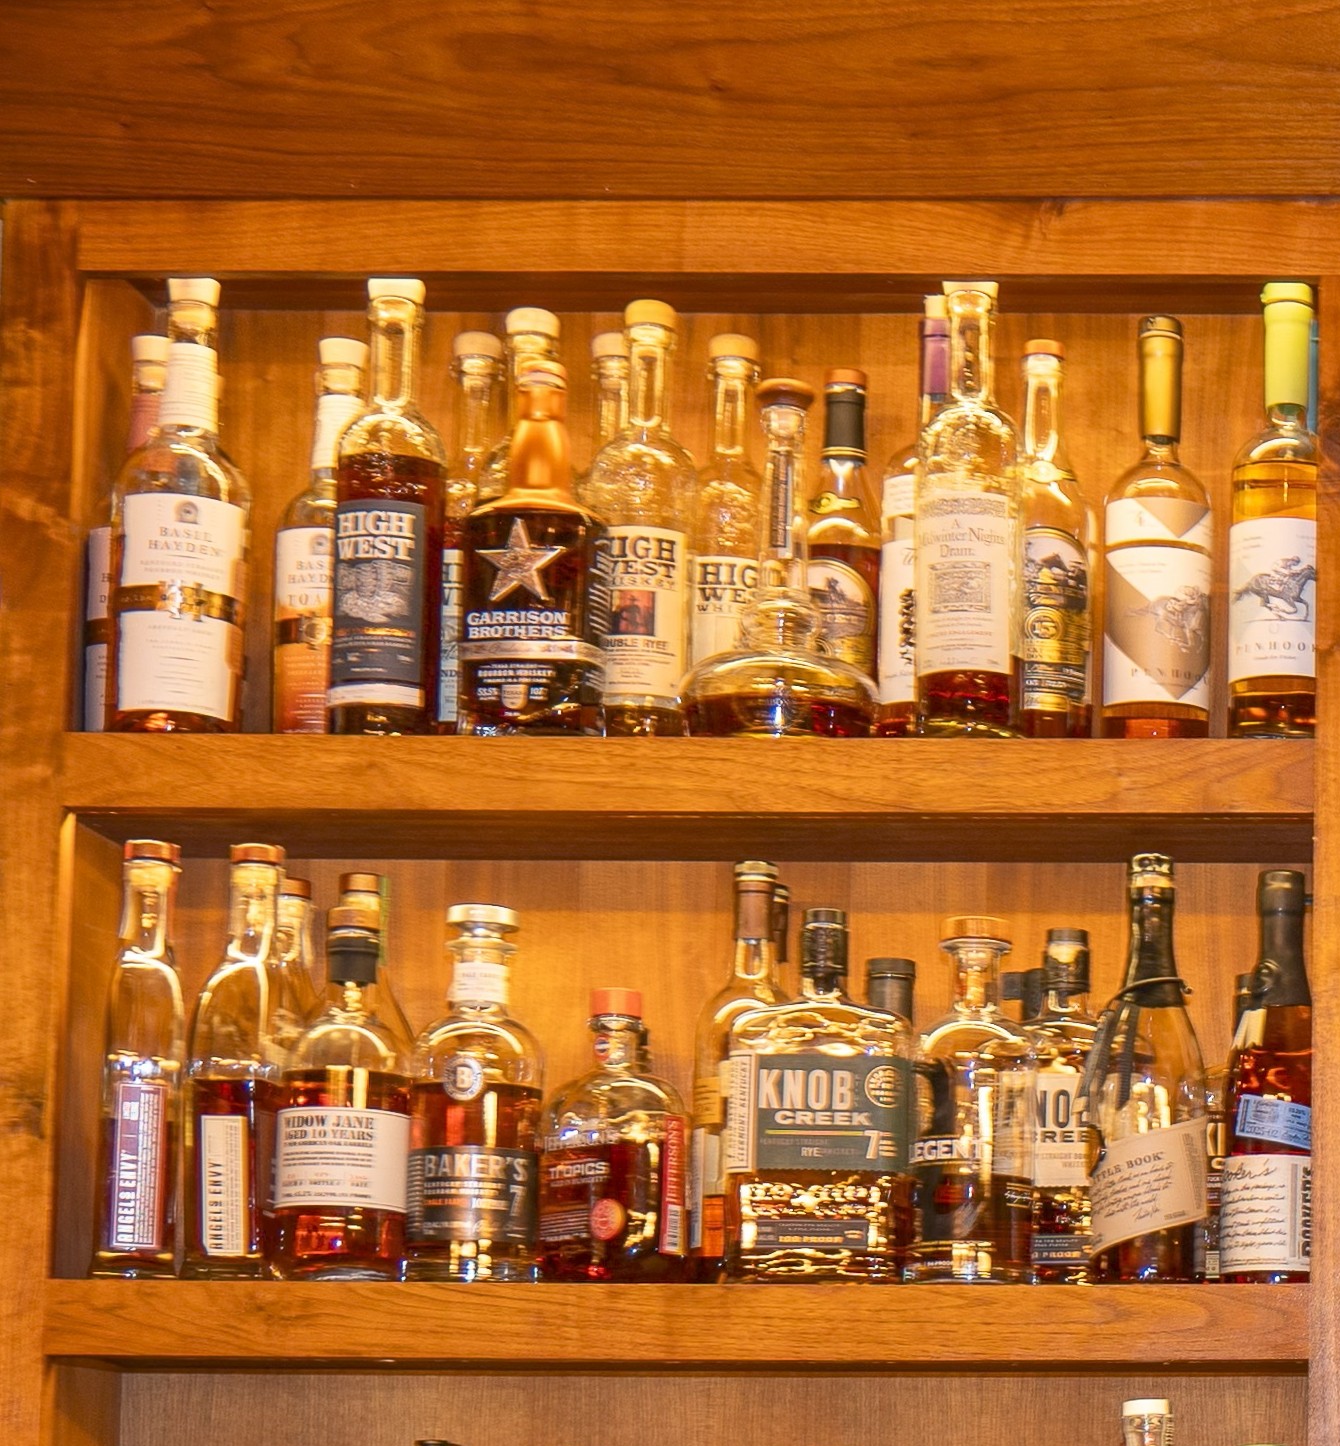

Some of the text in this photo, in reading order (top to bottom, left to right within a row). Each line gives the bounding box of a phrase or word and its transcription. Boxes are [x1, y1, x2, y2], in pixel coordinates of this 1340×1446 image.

[339, 511, 416, 537] HIGH
[339, 536, 415, 561] WEST
[467, 611, 569, 625] GARRISON
[467, 625, 568, 639] BROTHERS
[758, 1068, 854, 1111] KNOB
[332, 1117, 374, 1129] JANE
[774, 1110, 873, 1126] CREEK
[283, 1129, 373, 1141] AGED 10 YEARS
[863, 1129, 884, 1160] 7
[665, 1119, 683, 1205] JEFFERSON'S
[801, 1146, 822, 1158] RYE
[1126, 1153, 1161, 1170] BOOK
[121, 1149, 138, 1187] ENVY
[209, 1161, 224, 1195] ENVY
[424, 1153, 529, 1182] BAKER'S
[509, 1185, 527, 1217] 7
